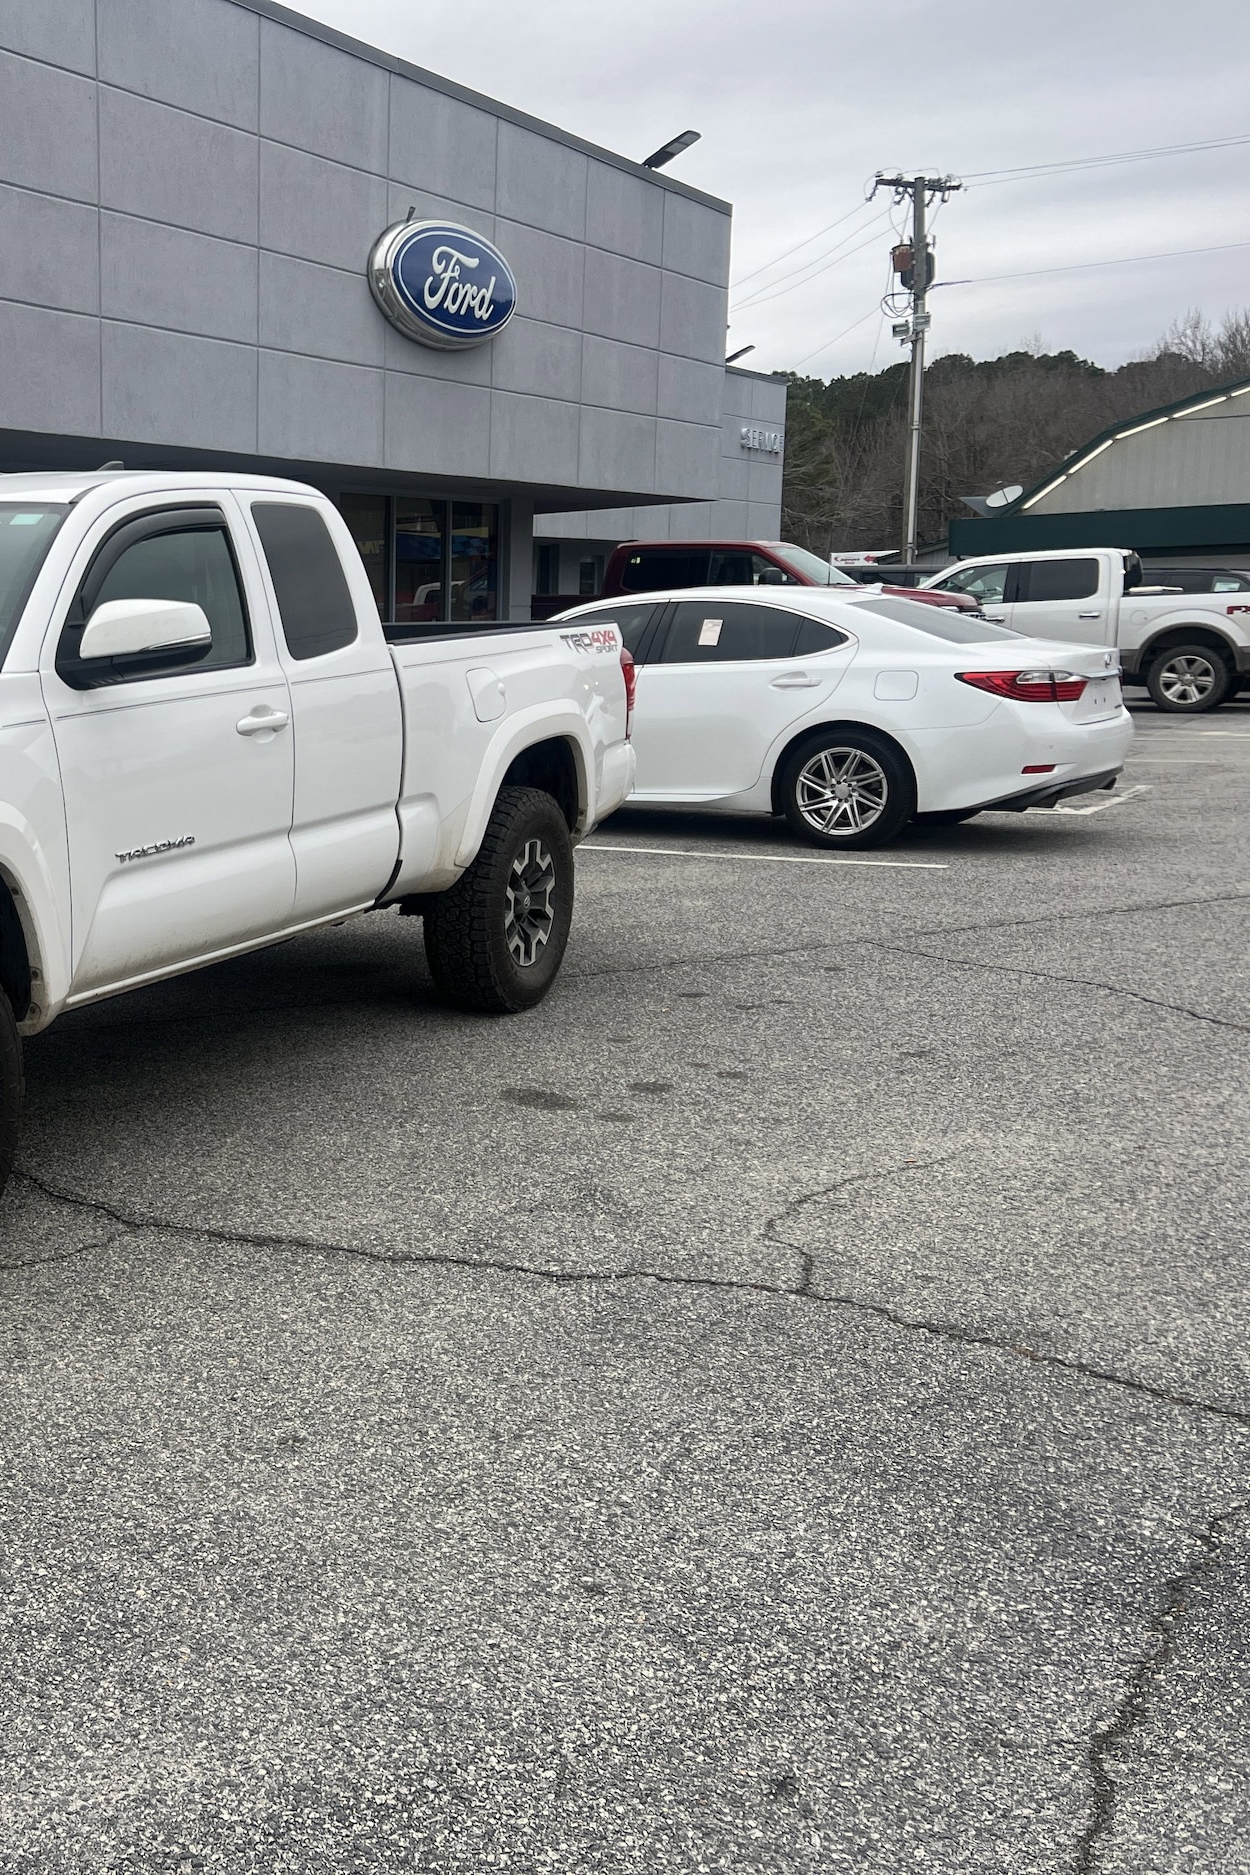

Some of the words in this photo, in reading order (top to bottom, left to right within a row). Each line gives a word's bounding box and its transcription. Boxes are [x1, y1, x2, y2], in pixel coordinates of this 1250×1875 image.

[424, 246, 496, 321] Ford
[741, 427, 785, 454] SERVICE
[559, 632, 593, 655] TRD
[595, 644, 618, 654] SPORT
[115, 835, 195, 864] TACOMA
